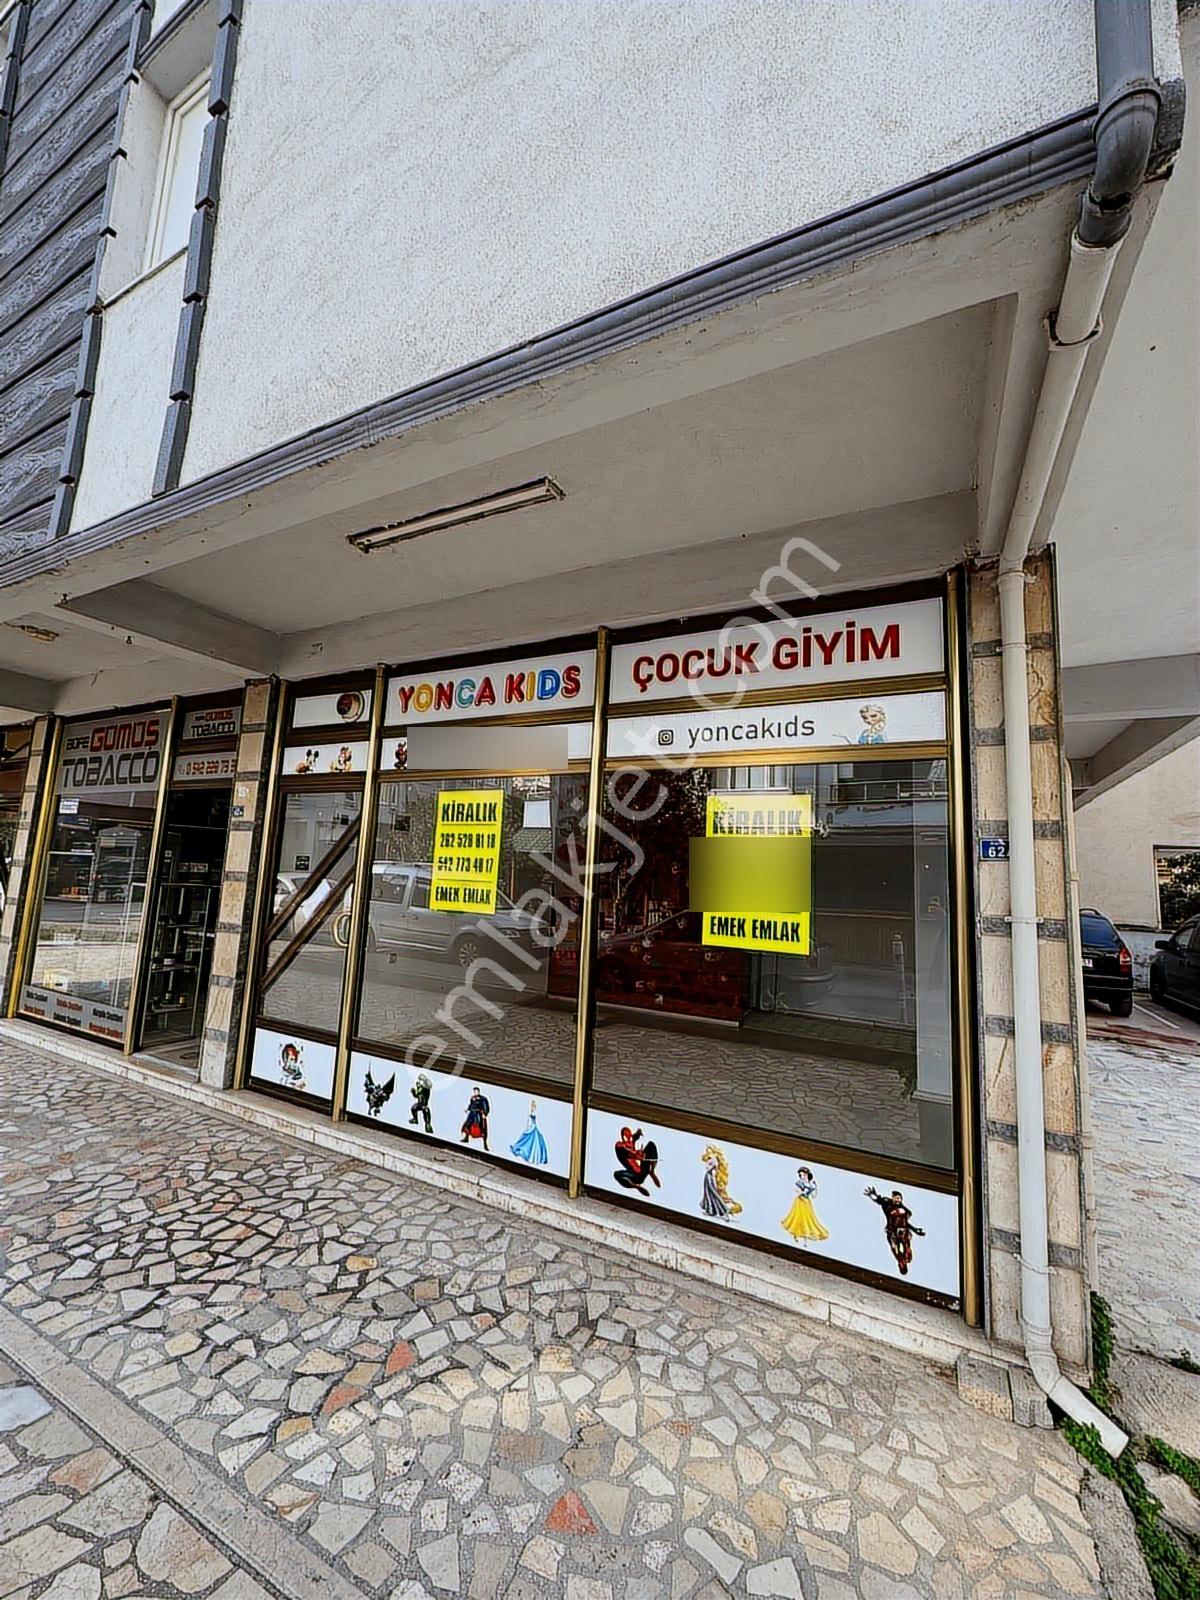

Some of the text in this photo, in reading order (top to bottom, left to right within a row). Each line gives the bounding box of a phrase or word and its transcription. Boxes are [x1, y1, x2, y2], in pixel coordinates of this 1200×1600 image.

[632, 621, 900, 693] ÇOCUK GİYİM
[399, 665, 582, 713] YONCA KIDS
[191, 721, 236, 738] TOBACCO
[62, 751, 160, 788] TOBACCO
[442, 800, 497, 822] KİRALIK
[712, 807, 802, 835] KİRALIK
[435, 886, 491, 905] EMEK EMLAK
[710, 916, 801, 943] EMEK EMLAK
